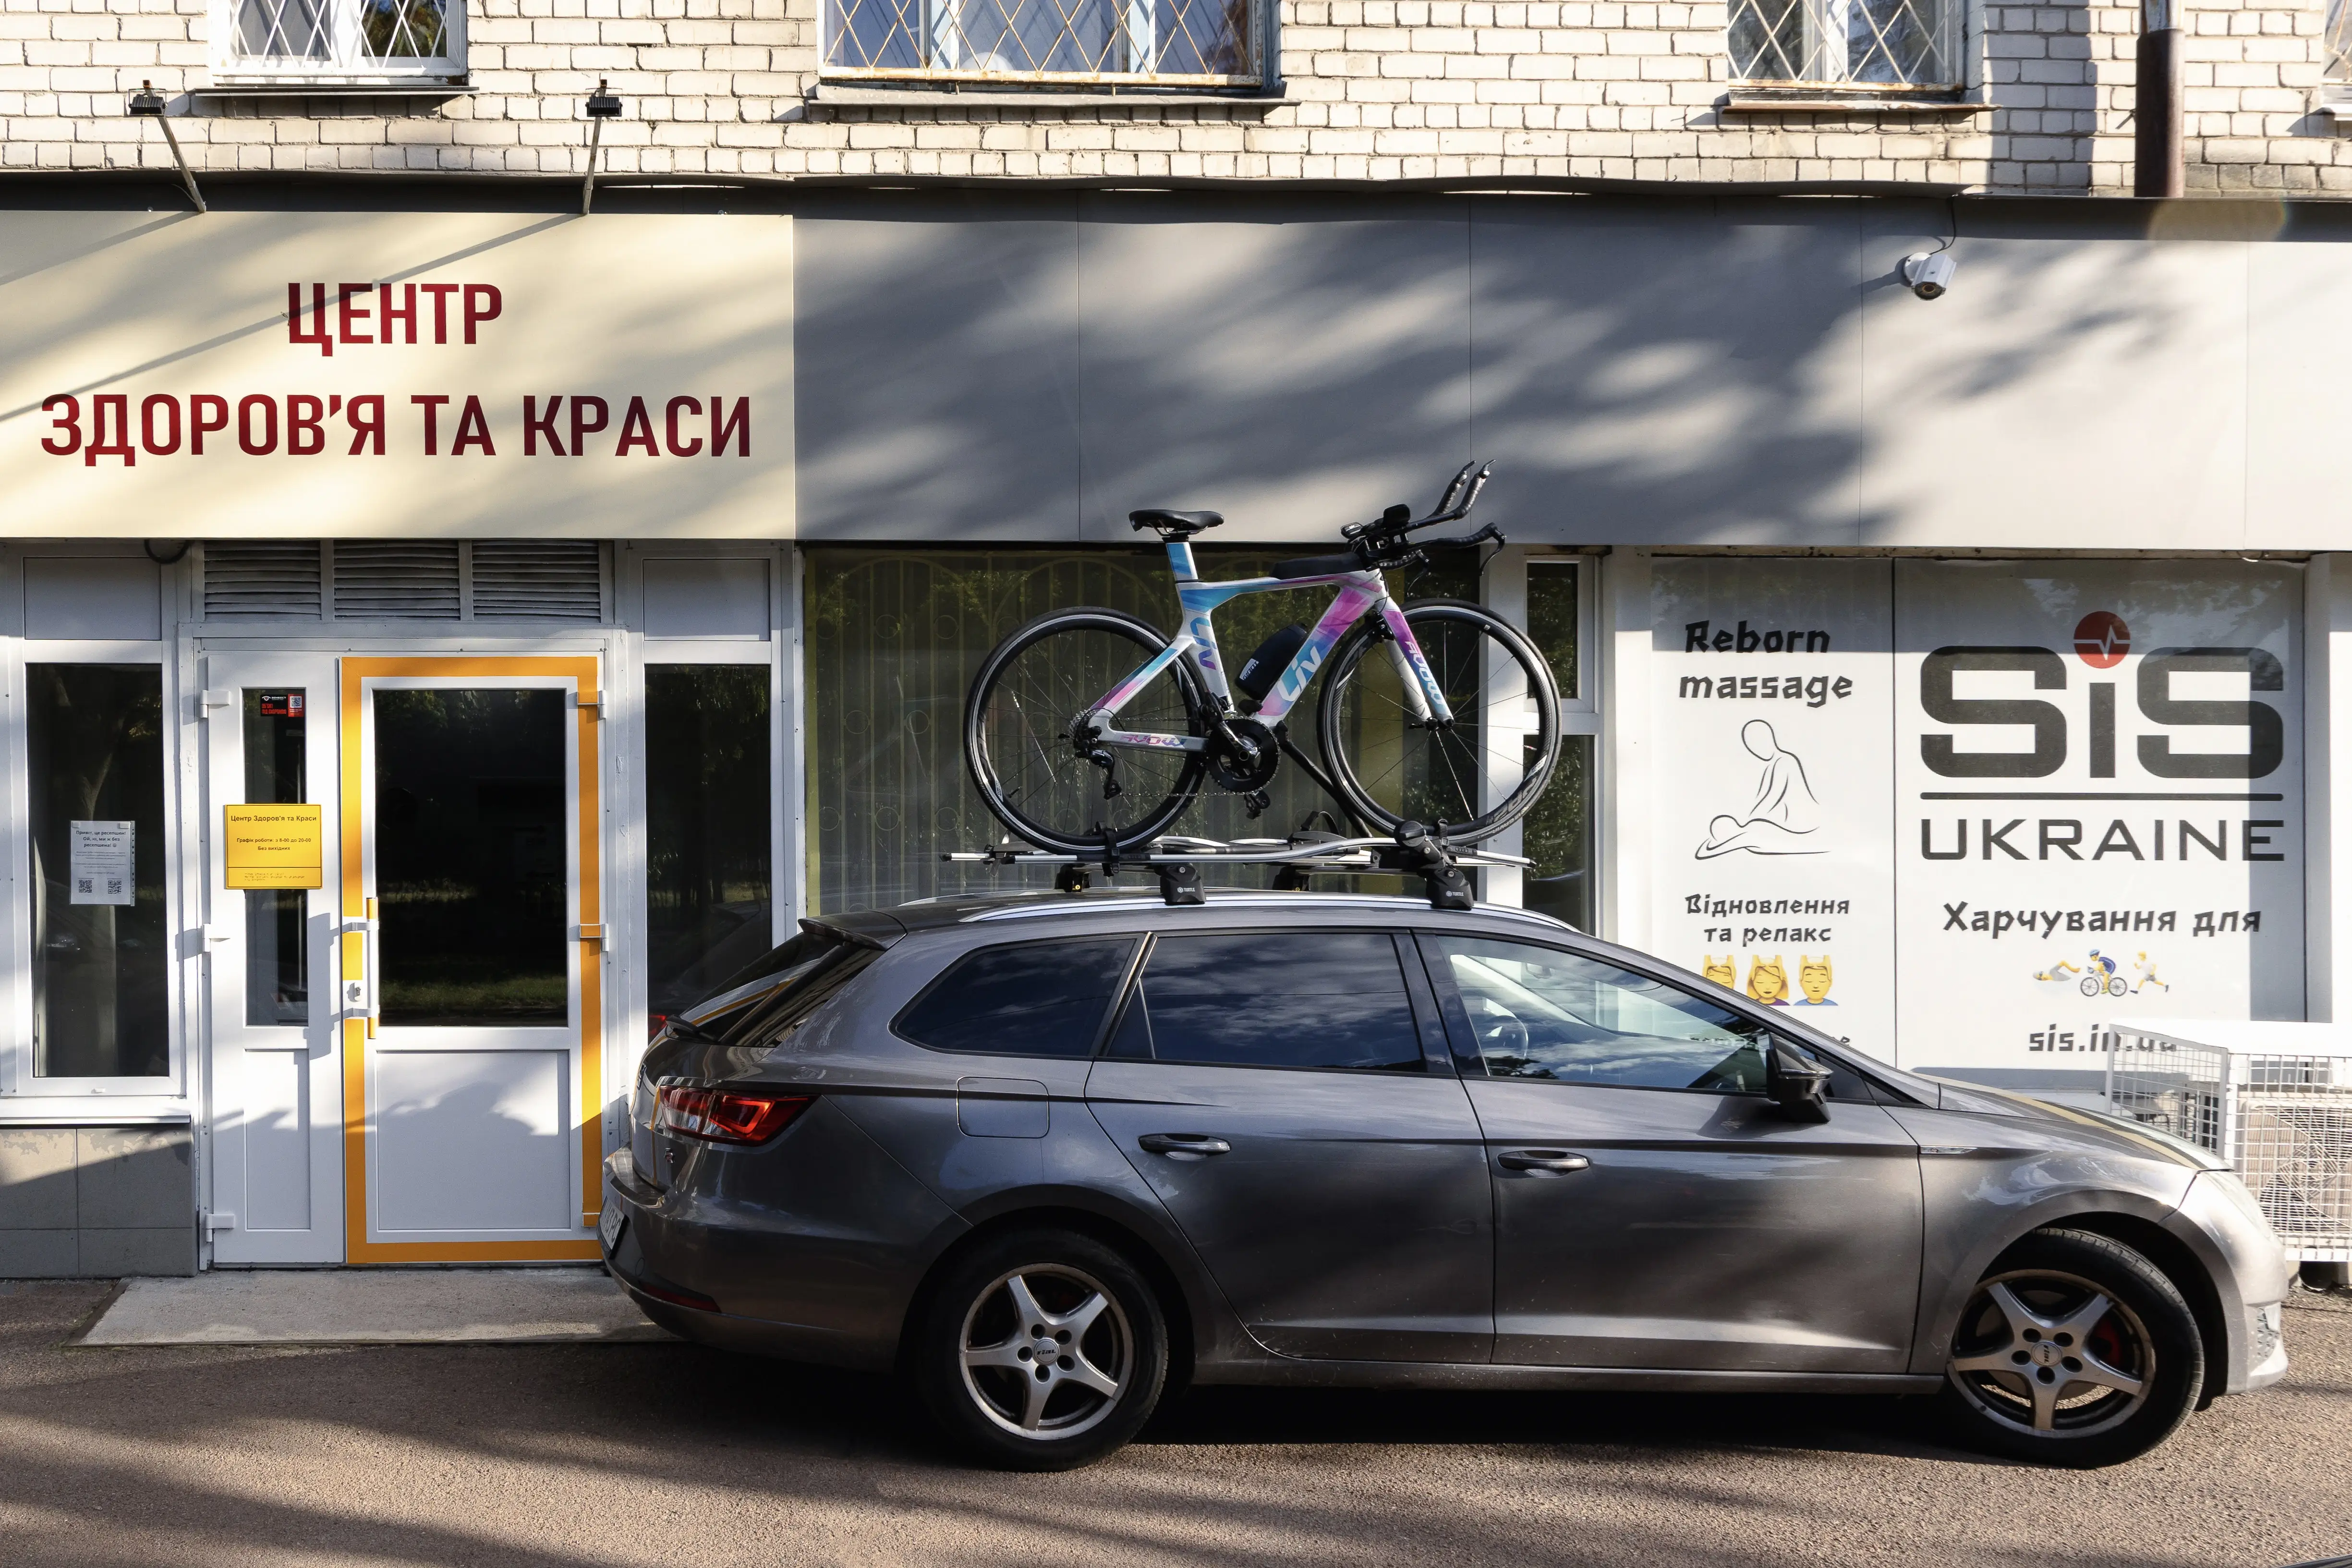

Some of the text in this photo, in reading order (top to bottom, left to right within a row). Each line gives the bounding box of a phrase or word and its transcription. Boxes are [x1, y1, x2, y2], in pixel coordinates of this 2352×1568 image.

[289, 283, 502, 357] ЦЕНТР
[41, 394, 750, 467] ЗДОРОВ'Я ТА КРАСИ
[1685, 620, 1831, 653] Reborn
[1679, 675, 1853, 708] massage
[1920, 611, 2284, 779] SiS
[1921, 819, 2285, 861] UKRAINE
[1685, 893, 1850, 917] Відновлення
[1943, 900, 2262, 940] Харчування для
[1704, 927, 1831, 948] та релакс
